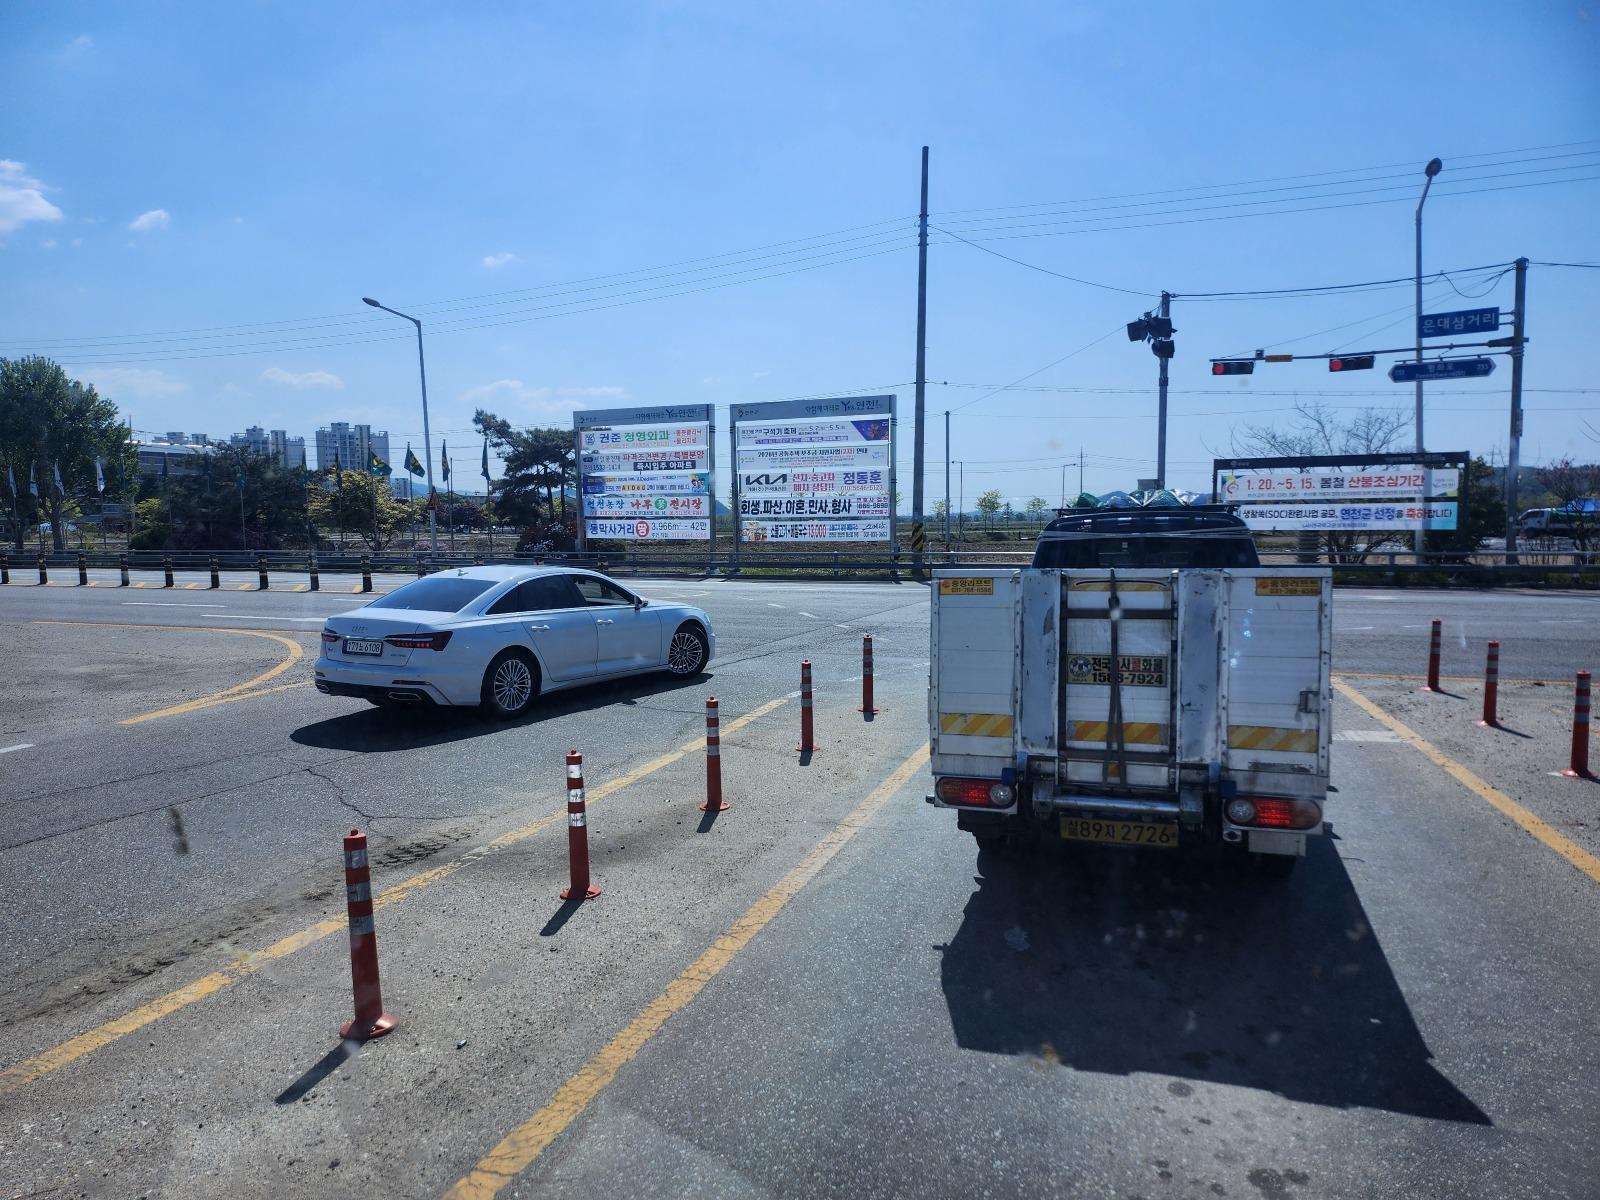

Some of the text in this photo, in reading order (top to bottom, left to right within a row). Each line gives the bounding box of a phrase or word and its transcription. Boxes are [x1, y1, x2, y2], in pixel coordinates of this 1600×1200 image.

[1422, 312, 1496, 334] 은대삼거리
[600, 430, 670, 444] 권준 정형외과
[669, 460, 693, 469] 아파트
[745, 473, 788, 486] KIA
[843, 471, 882, 485] 정동훈
[1320, 476, 1345, 489] 봄철
[1348, 474, 1425, 488] 산불조심기간
[630, 498, 653, 510] 나무
[669, 497, 703, 510] 전시장
[1340, 507, 1371, 520] 연천군
[1405, 507, 1452, 520] 축하합니다
[589, 523, 635, 535] 동막사거리
[952, 578, 992, 587] 중앙리프트
[1080, 821, 1116, 840] 89자
[1120, 823, 1171, 844] 2726
